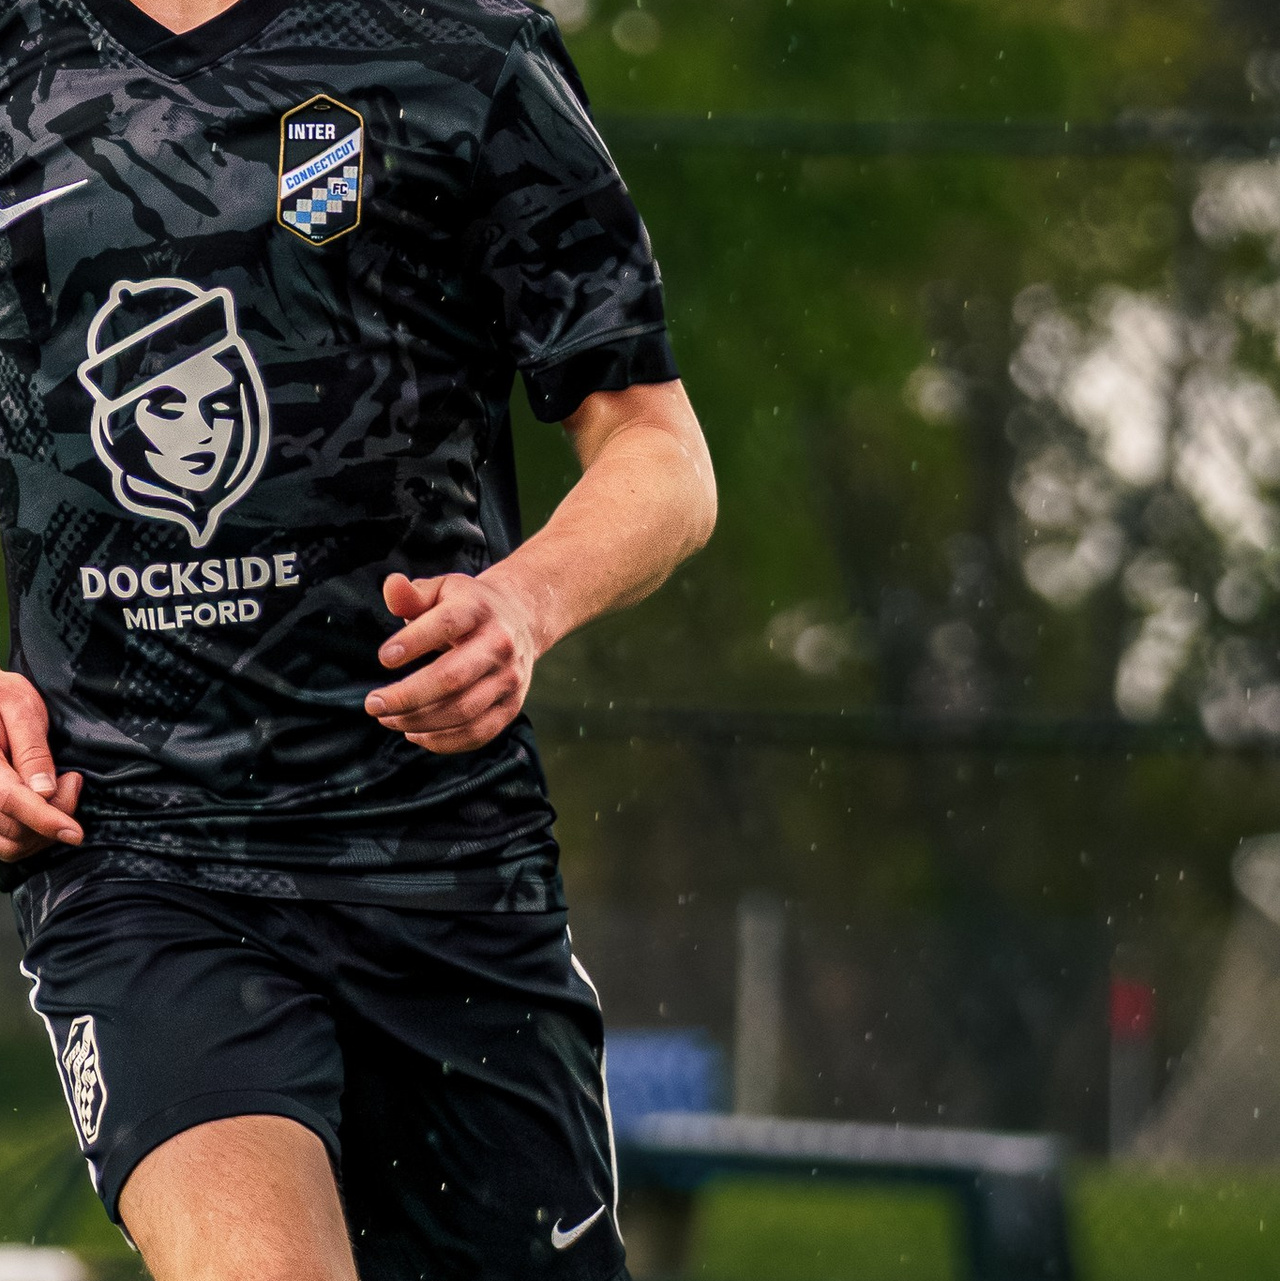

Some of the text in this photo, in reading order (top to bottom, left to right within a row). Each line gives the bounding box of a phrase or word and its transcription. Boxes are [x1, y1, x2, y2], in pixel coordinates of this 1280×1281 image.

[288, 123, 336, 140] INTER
[286, 139, 356, 190] CONNECTICUT
[332, 183, 348, 195] FC
[79, 552, 300, 599] DOCKSIDE
[123, 599, 260, 630] MILFORD
